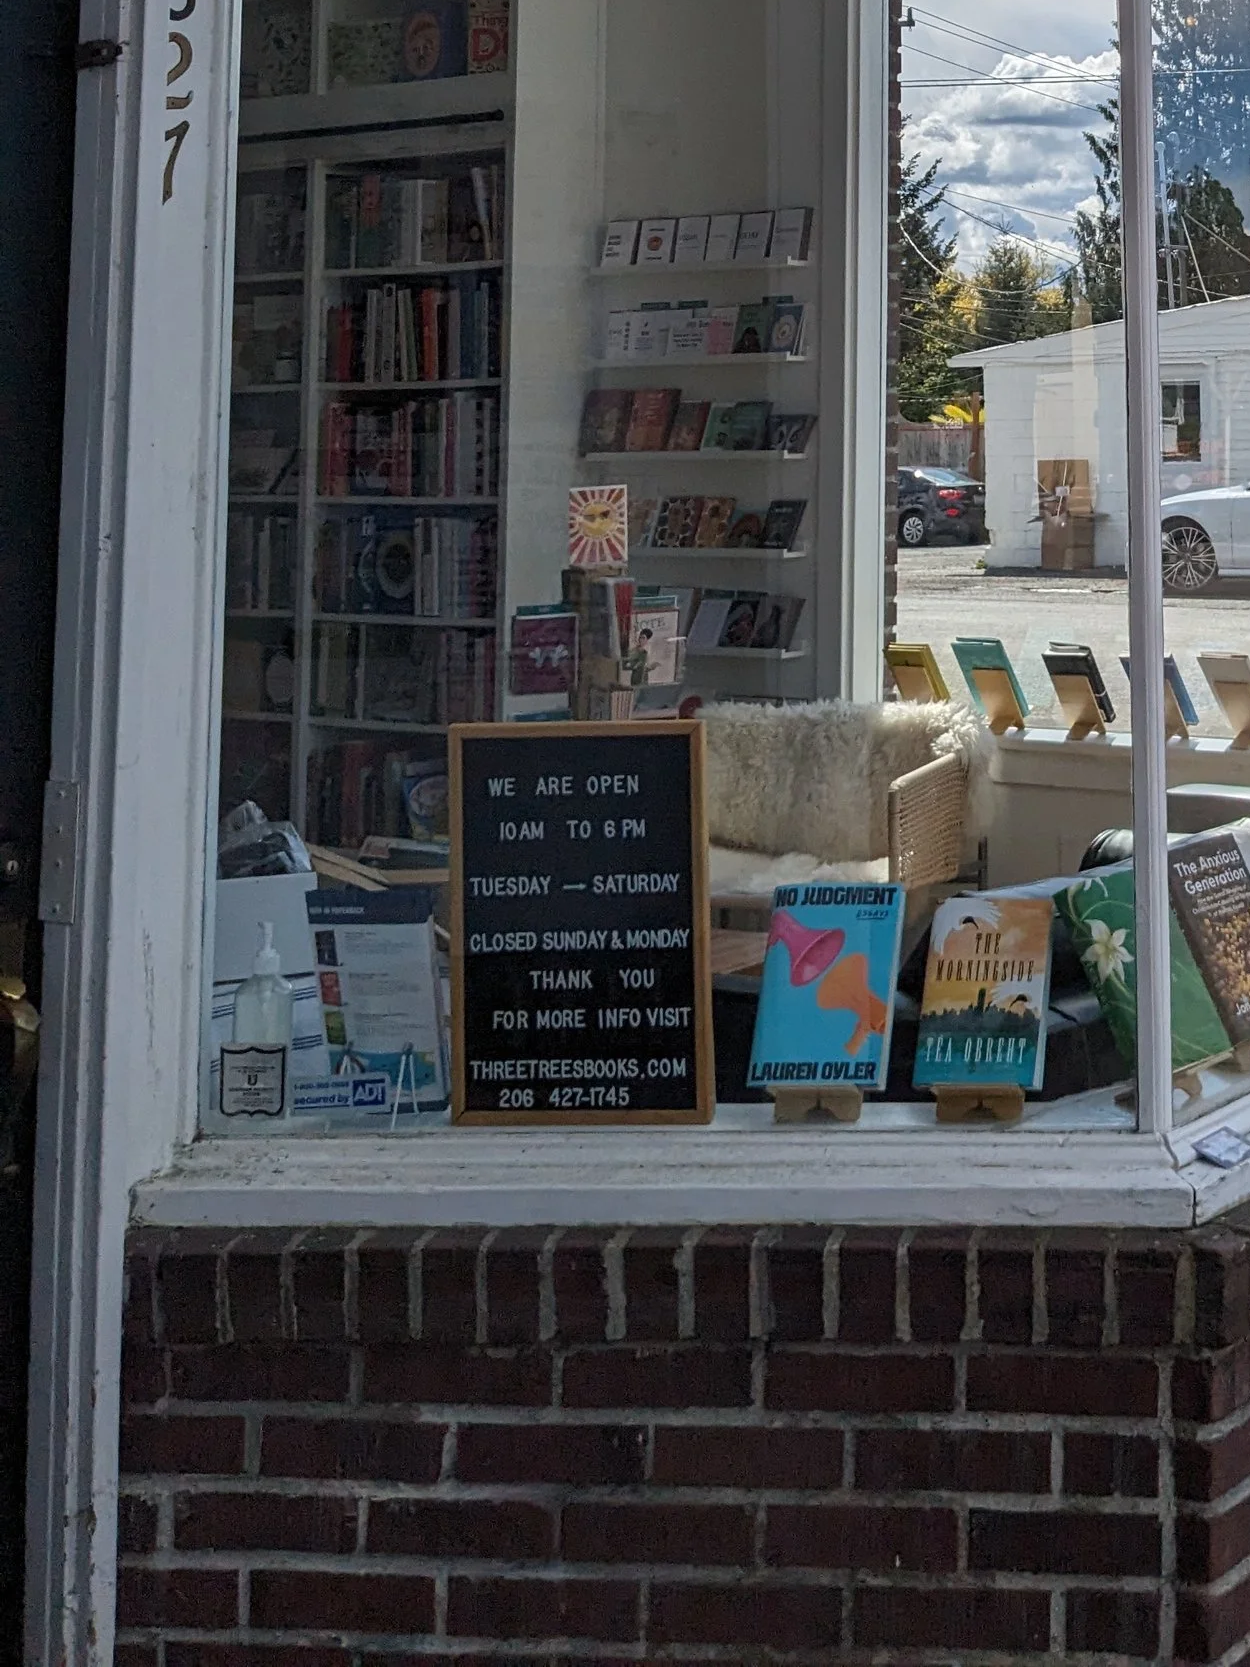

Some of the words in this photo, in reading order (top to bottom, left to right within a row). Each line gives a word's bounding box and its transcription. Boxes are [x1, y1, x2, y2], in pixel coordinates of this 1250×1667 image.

[488, 777, 516, 797] WE
[535, 776, 574, 796] ARE
[586, 774, 640, 796] OPEN
[567, 820, 591, 839] TO
[1173, 861, 1198, 877] The
[1199, 849, 1241, 871] Anxious
[470, 876, 552, 896] TUESDAY
[592, 874, 680, 894] SATURDAY
[1184, 867, 1247, 895] Generation
[776, 887, 798, 909] NO
[800, 886, 898, 907] JUDGMENT
[470, 932, 537, 953] CLOSED
[542, 930, 606, 951] SUNDAY
[610, 931, 624, 950] &
[625, 928, 690, 949] MONDAY
[974, 933, 1001, 955] THE
[530, 970, 592, 990] THANK
[619, 969, 655, 989] YOU
[935, 959, 1035, 983] MORNINGSIDE
[493, 1010, 529, 1030] FOR
[536, 1009, 586, 1029] MORE
[599, 1007, 642, 1029] INFO
[646, 1007, 692, 1028] VISIT
[964, 1037, 1027, 1063] OBREHT
[470, 1058, 687, 1080] THREETREESBOOKS.COM
[751, 1062, 818, 1082] LAUREN
[820, 1061, 877, 1081] OYLER
[500, 1088, 534, 1108] 206
[548, 1086, 630, 1107] 427-1745
